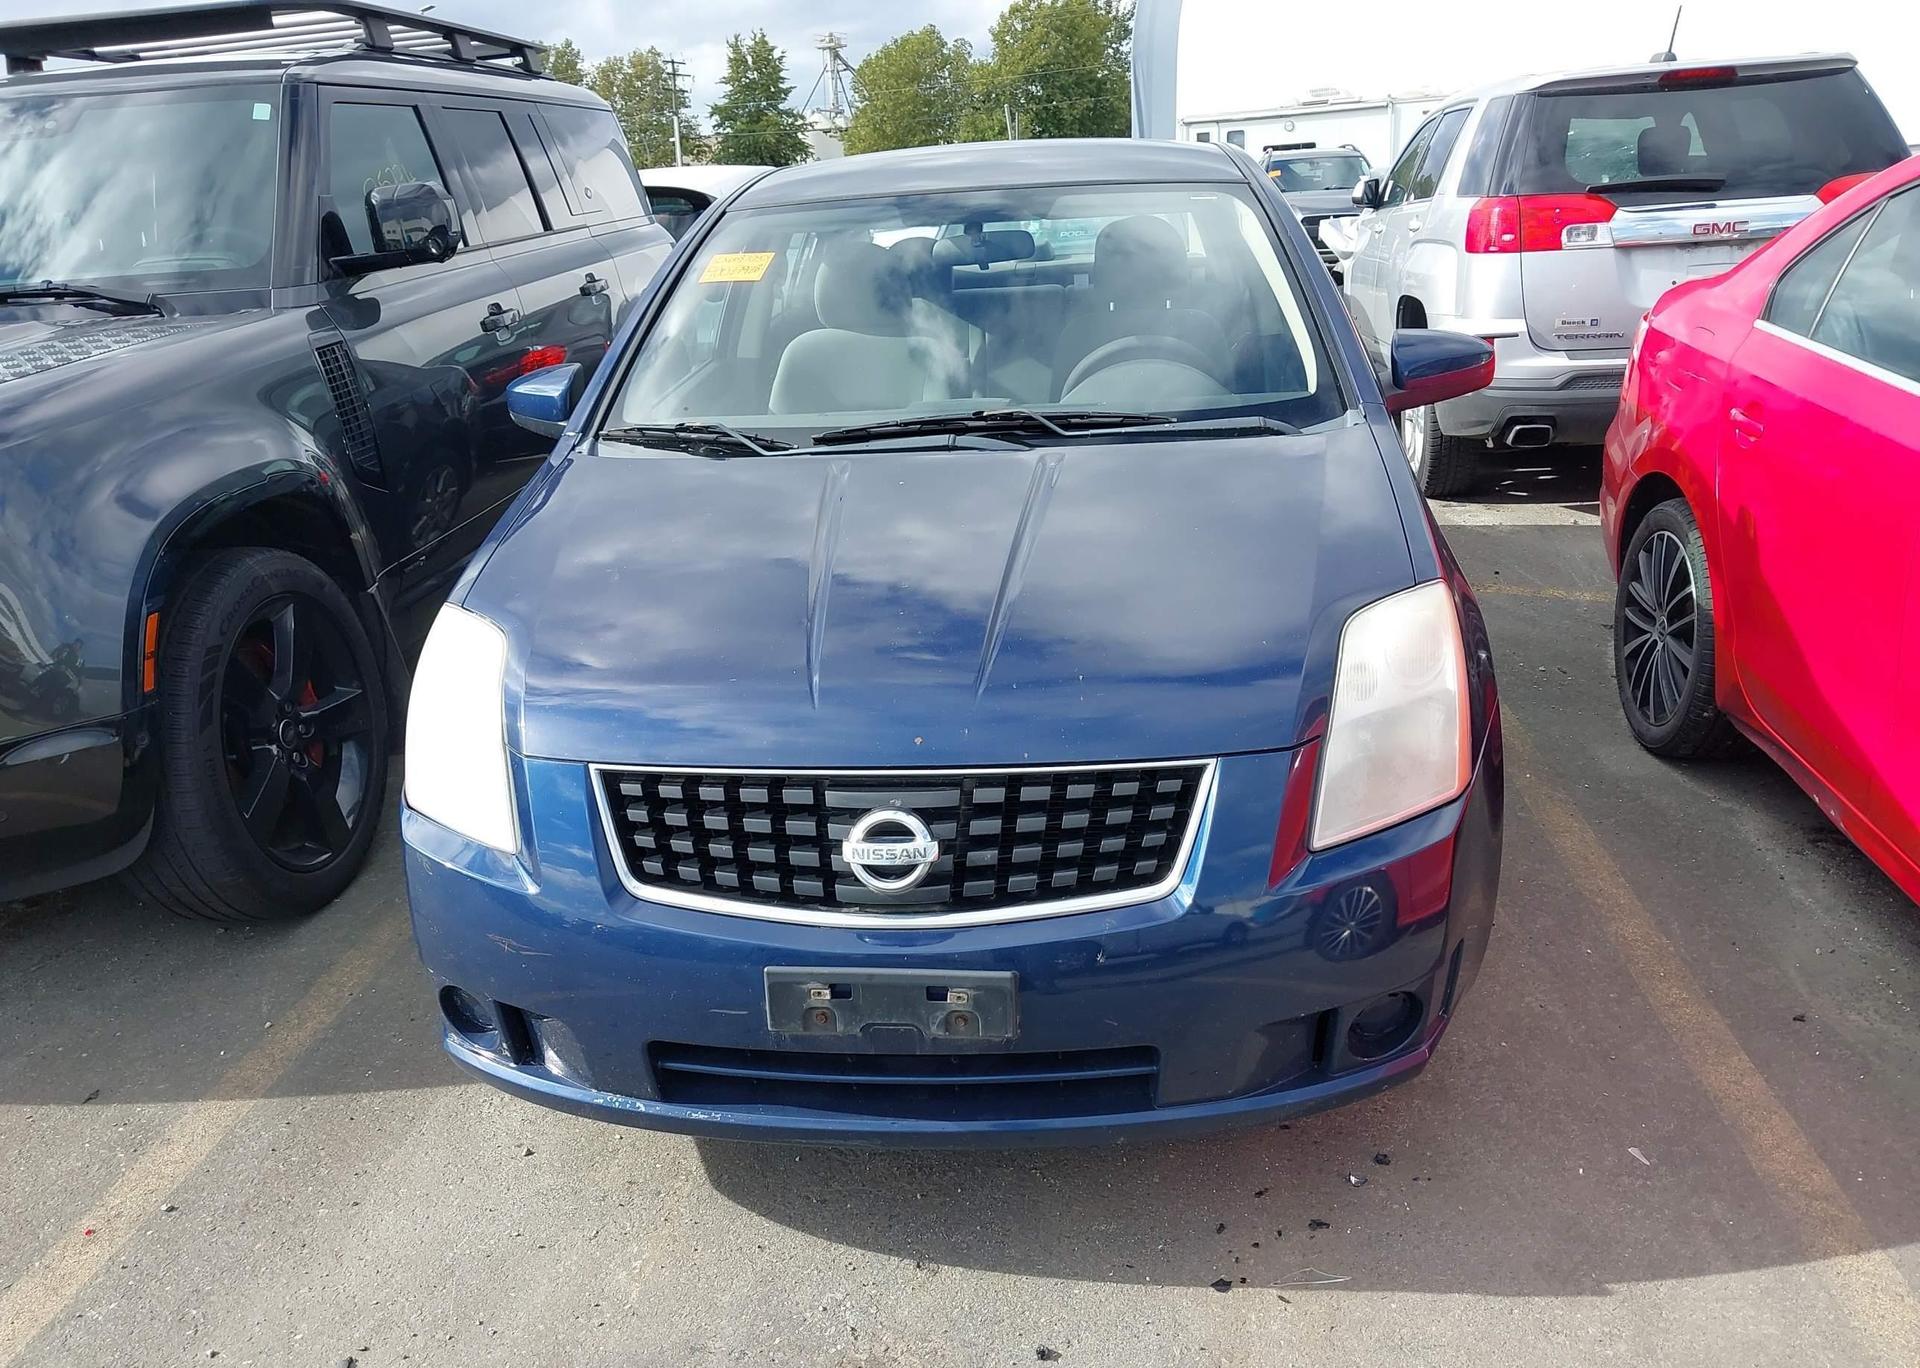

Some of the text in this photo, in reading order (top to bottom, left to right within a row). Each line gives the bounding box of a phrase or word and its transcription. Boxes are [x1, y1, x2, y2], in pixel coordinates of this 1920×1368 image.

[1692, 220, 1749, 236] GMC
[1553, 331, 1625, 340] TERRAIN
[851, 847, 927, 861] NISSAN
